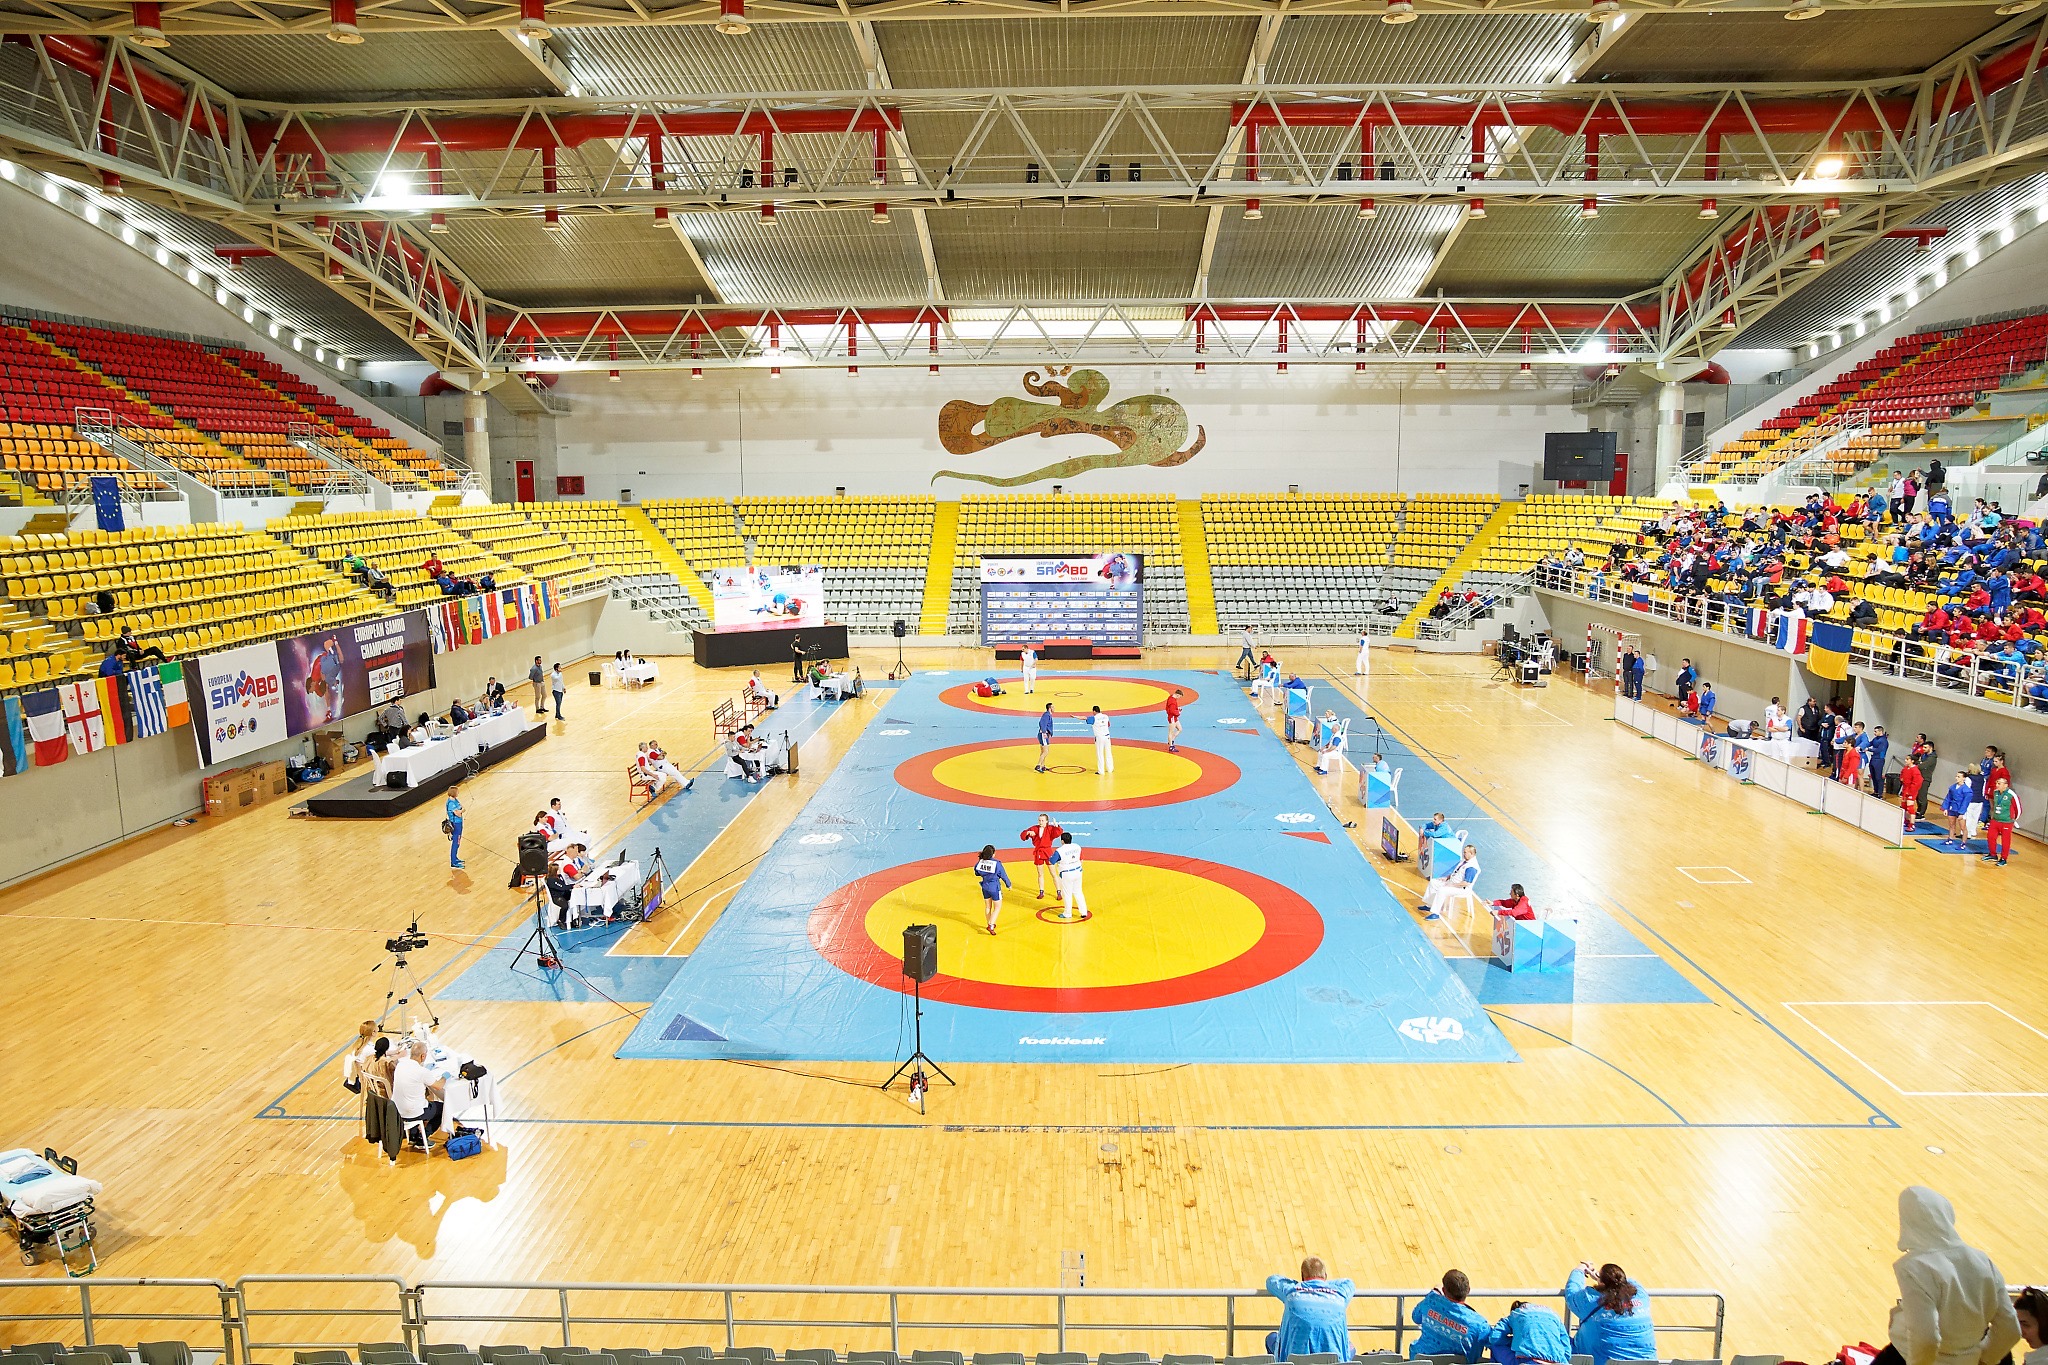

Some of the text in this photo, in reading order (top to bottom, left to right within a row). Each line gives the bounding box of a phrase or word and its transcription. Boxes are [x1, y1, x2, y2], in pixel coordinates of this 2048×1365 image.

[1036, 561, 1088, 576] SAMBO
[353, 622, 385, 643] EUROPEAN
[360, 635, 405, 660] CHAMPIONSHIP
[207, 673, 233, 688] EUROPEAN
[210, 670, 279, 710] SAMBO
[1018, 1036, 1107, 1045] foeldeak
[1427, 1309, 1468, 1335] BELARUS
